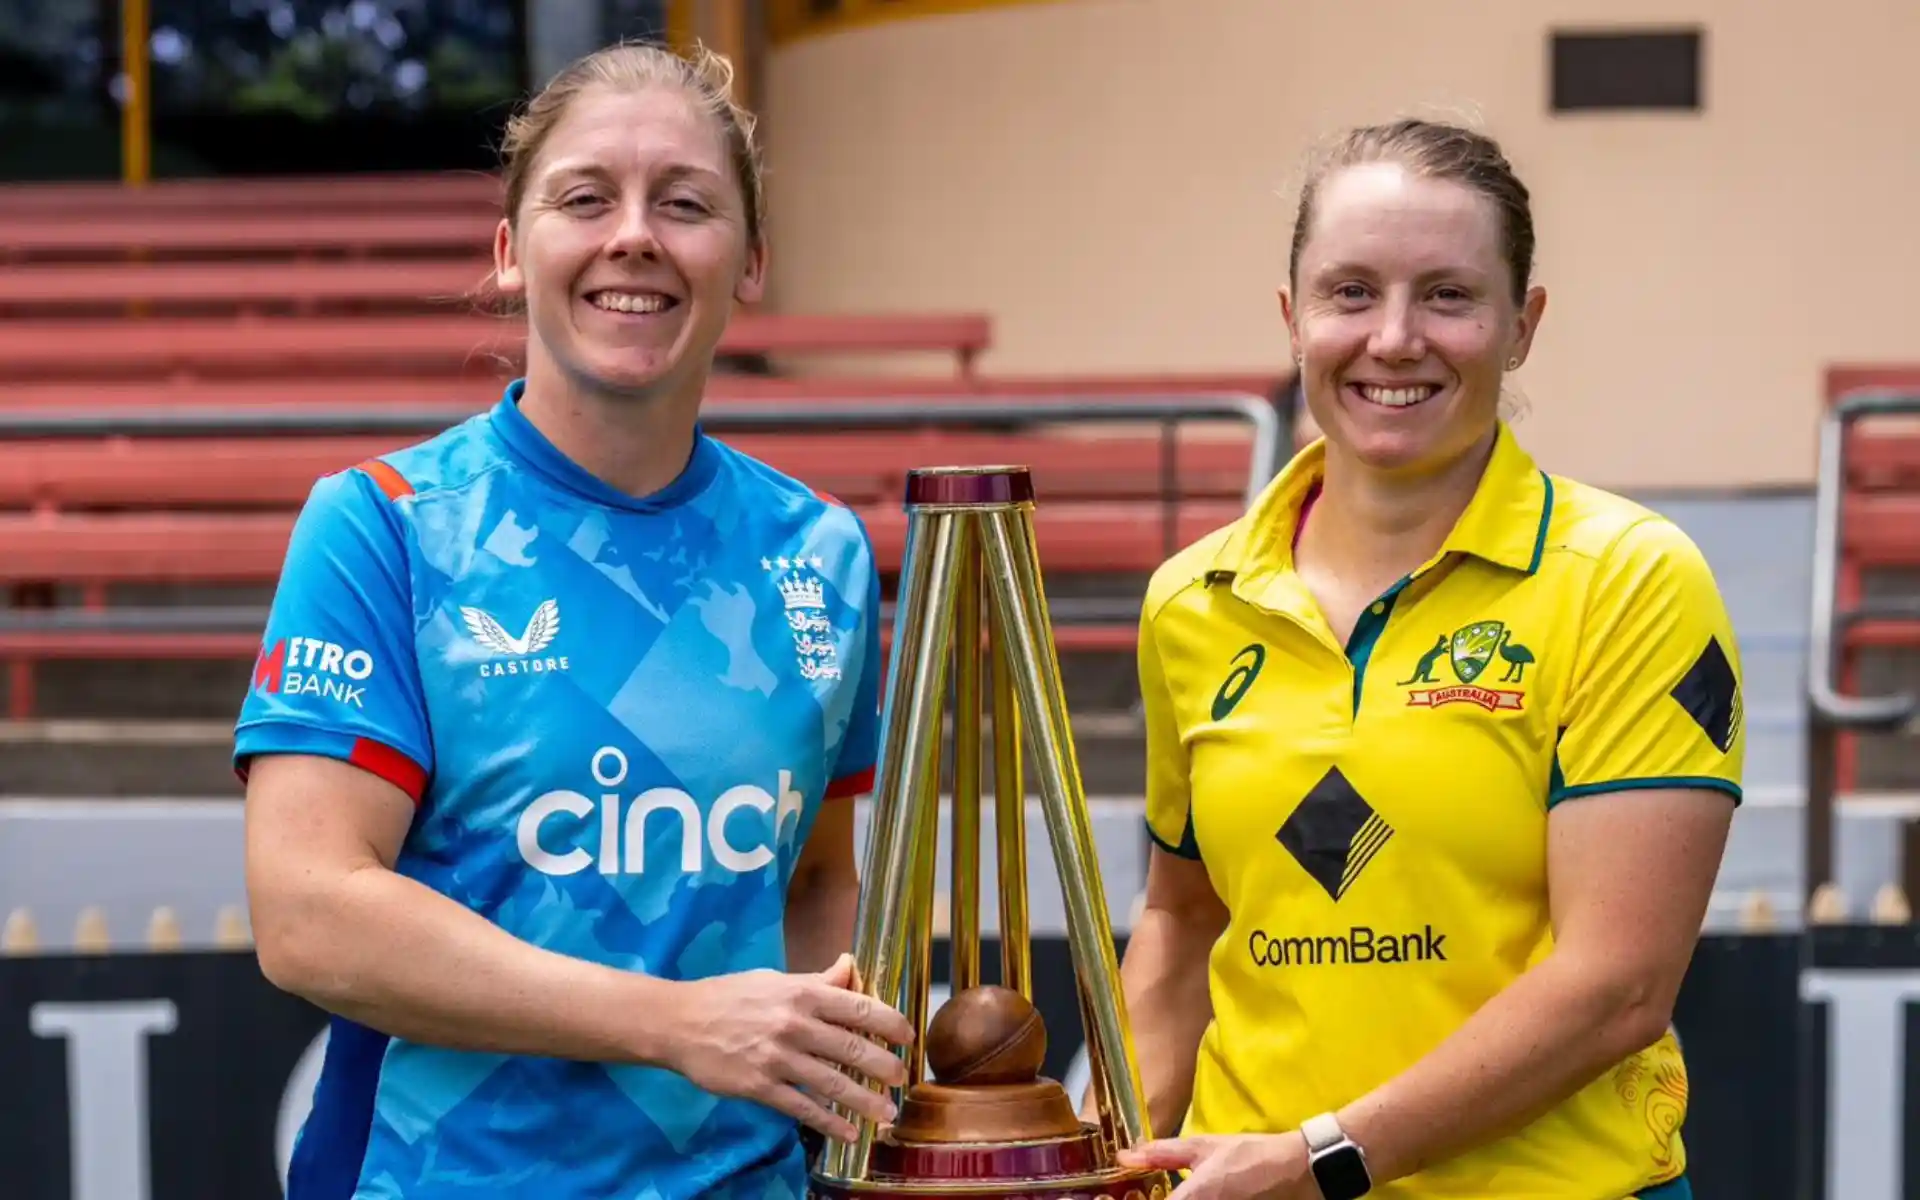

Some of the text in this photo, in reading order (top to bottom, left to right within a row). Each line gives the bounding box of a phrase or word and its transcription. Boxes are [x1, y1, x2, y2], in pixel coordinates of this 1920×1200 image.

[255, 637, 374, 693] METRO
[480, 656, 569, 677] CASTORE
[283, 672, 366, 708] BANK
[1435, 687, 1493, 705] AUSTRALIA
[516, 746, 803, 875] cinch
[1249, 924, 1447, 966] CommBank
